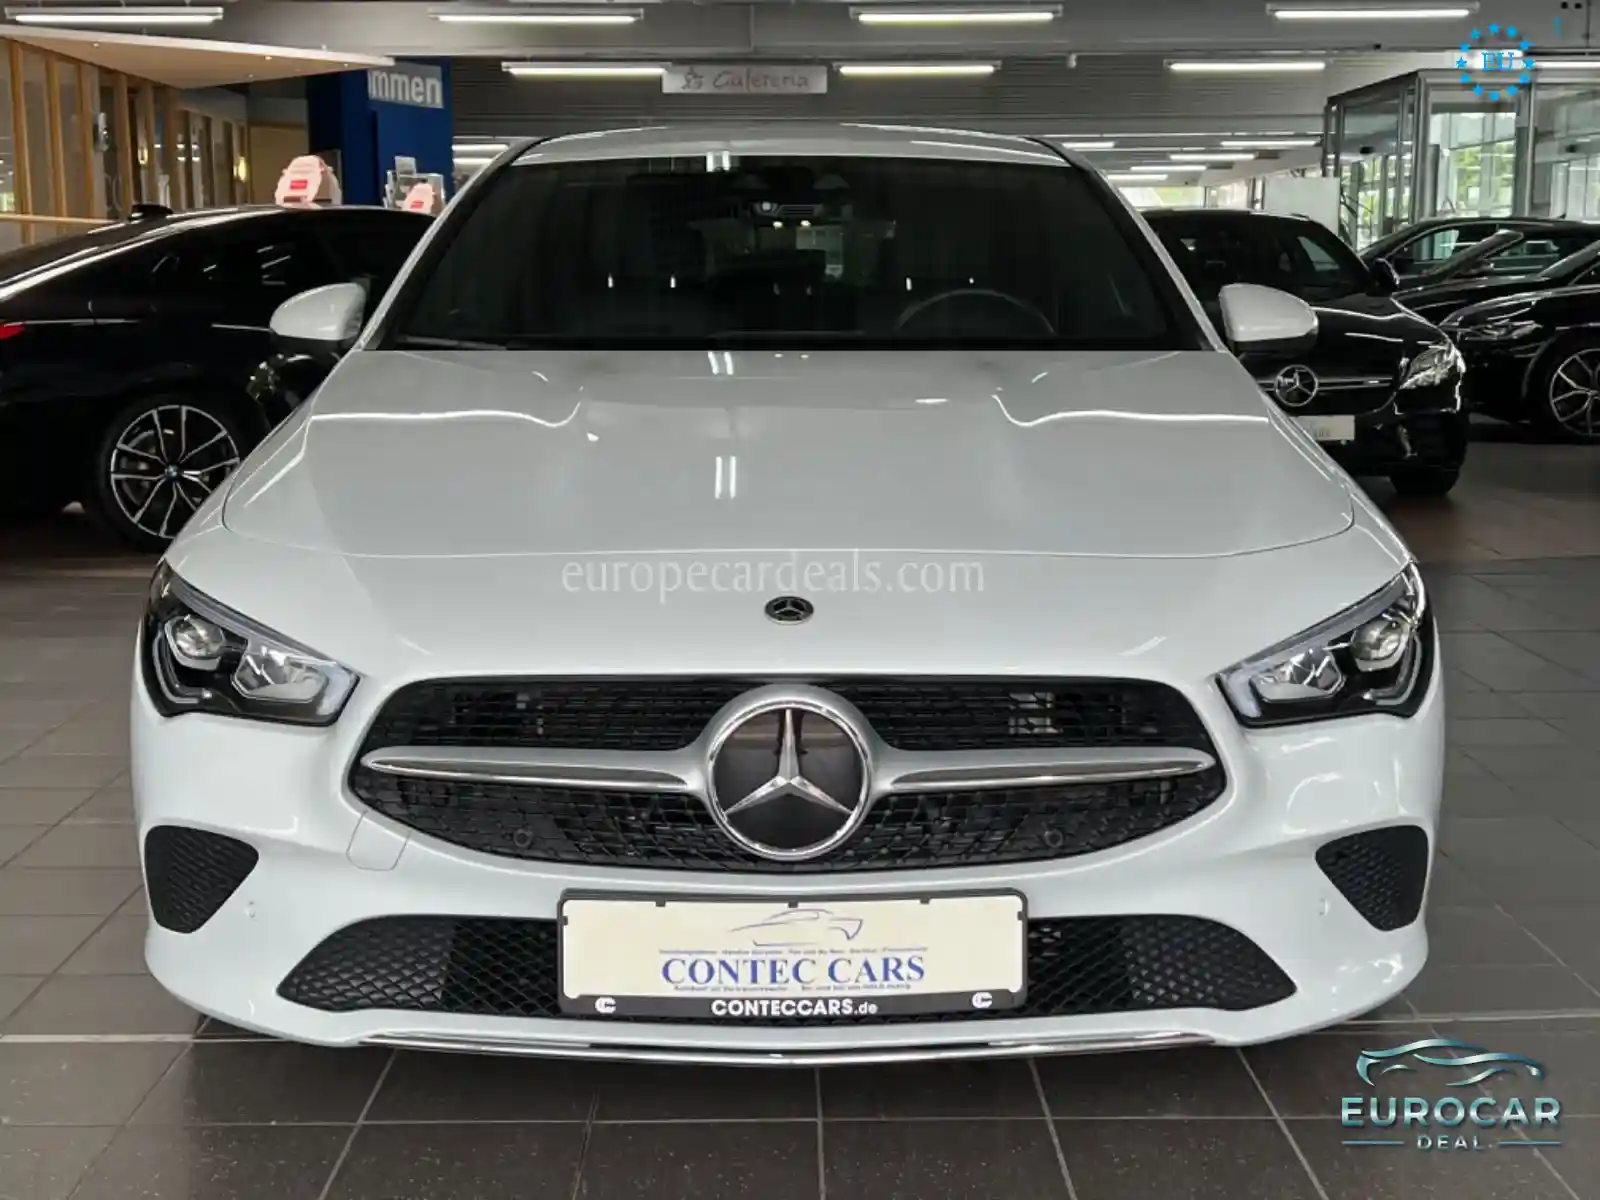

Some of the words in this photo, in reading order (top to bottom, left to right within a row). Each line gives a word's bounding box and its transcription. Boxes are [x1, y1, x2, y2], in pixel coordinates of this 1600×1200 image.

[368, 70, 443, 105] mmen
[662, 957, 817, 985] CONTEC
[828, 955, 925, 983] CARS
[711, 998, 878, 1016] CONTECCARS.de
